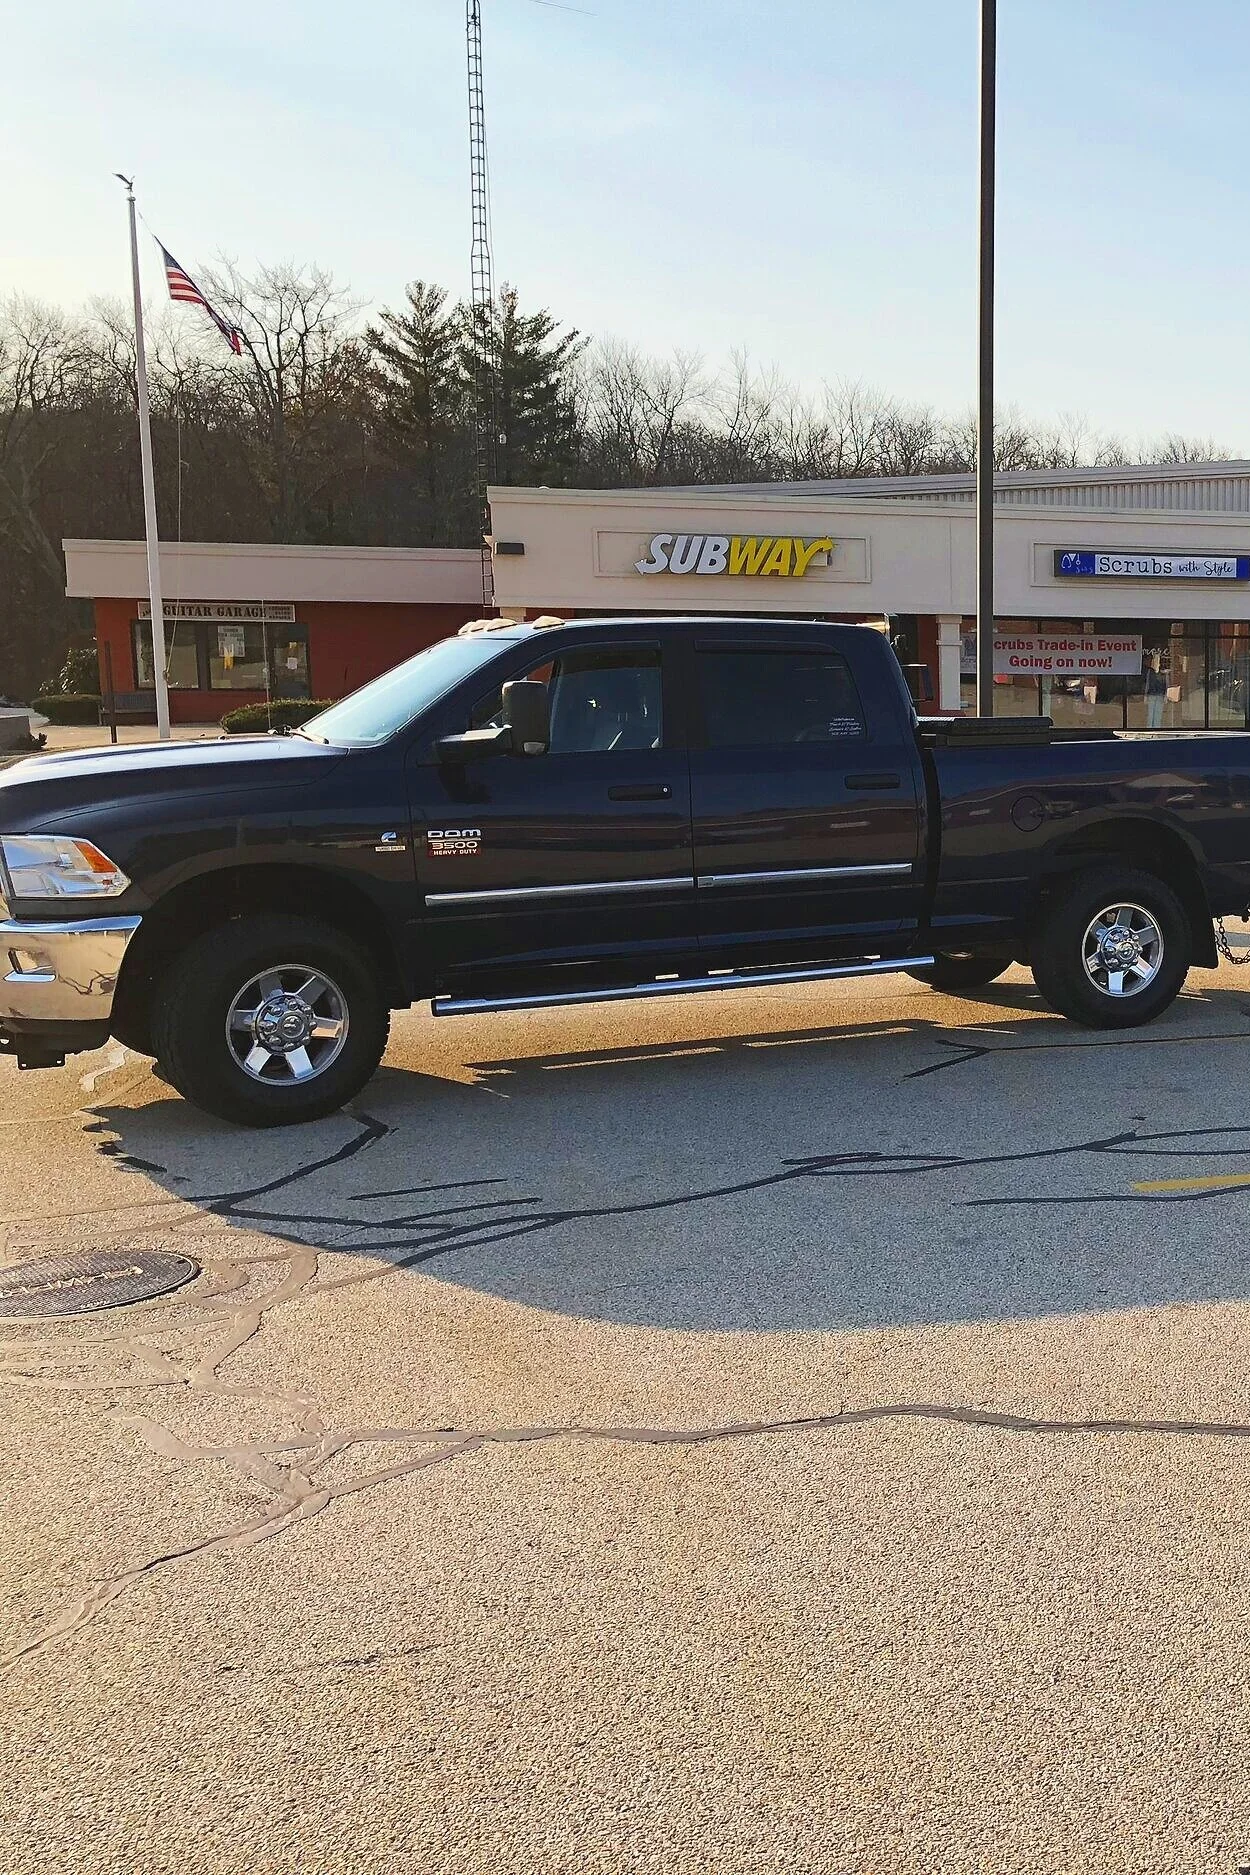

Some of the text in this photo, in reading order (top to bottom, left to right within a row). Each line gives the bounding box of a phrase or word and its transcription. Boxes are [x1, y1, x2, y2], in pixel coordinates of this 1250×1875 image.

[634, 534, 835, 576] SUBWAY
[1099, 557, 1172, 574] Scrubs
[1178, 560, 1200, 573] with
[1203, 558, 1233, 576] Style
[163, 605, 212, 617] GUITAR
[217, 605, 267, 618] GARAGE
[992, 639, 1137, 651] crubs Trade-in Event
[1009, 655, 1113, 669] Going on now!
[431, 840, 478, 850] 3500
